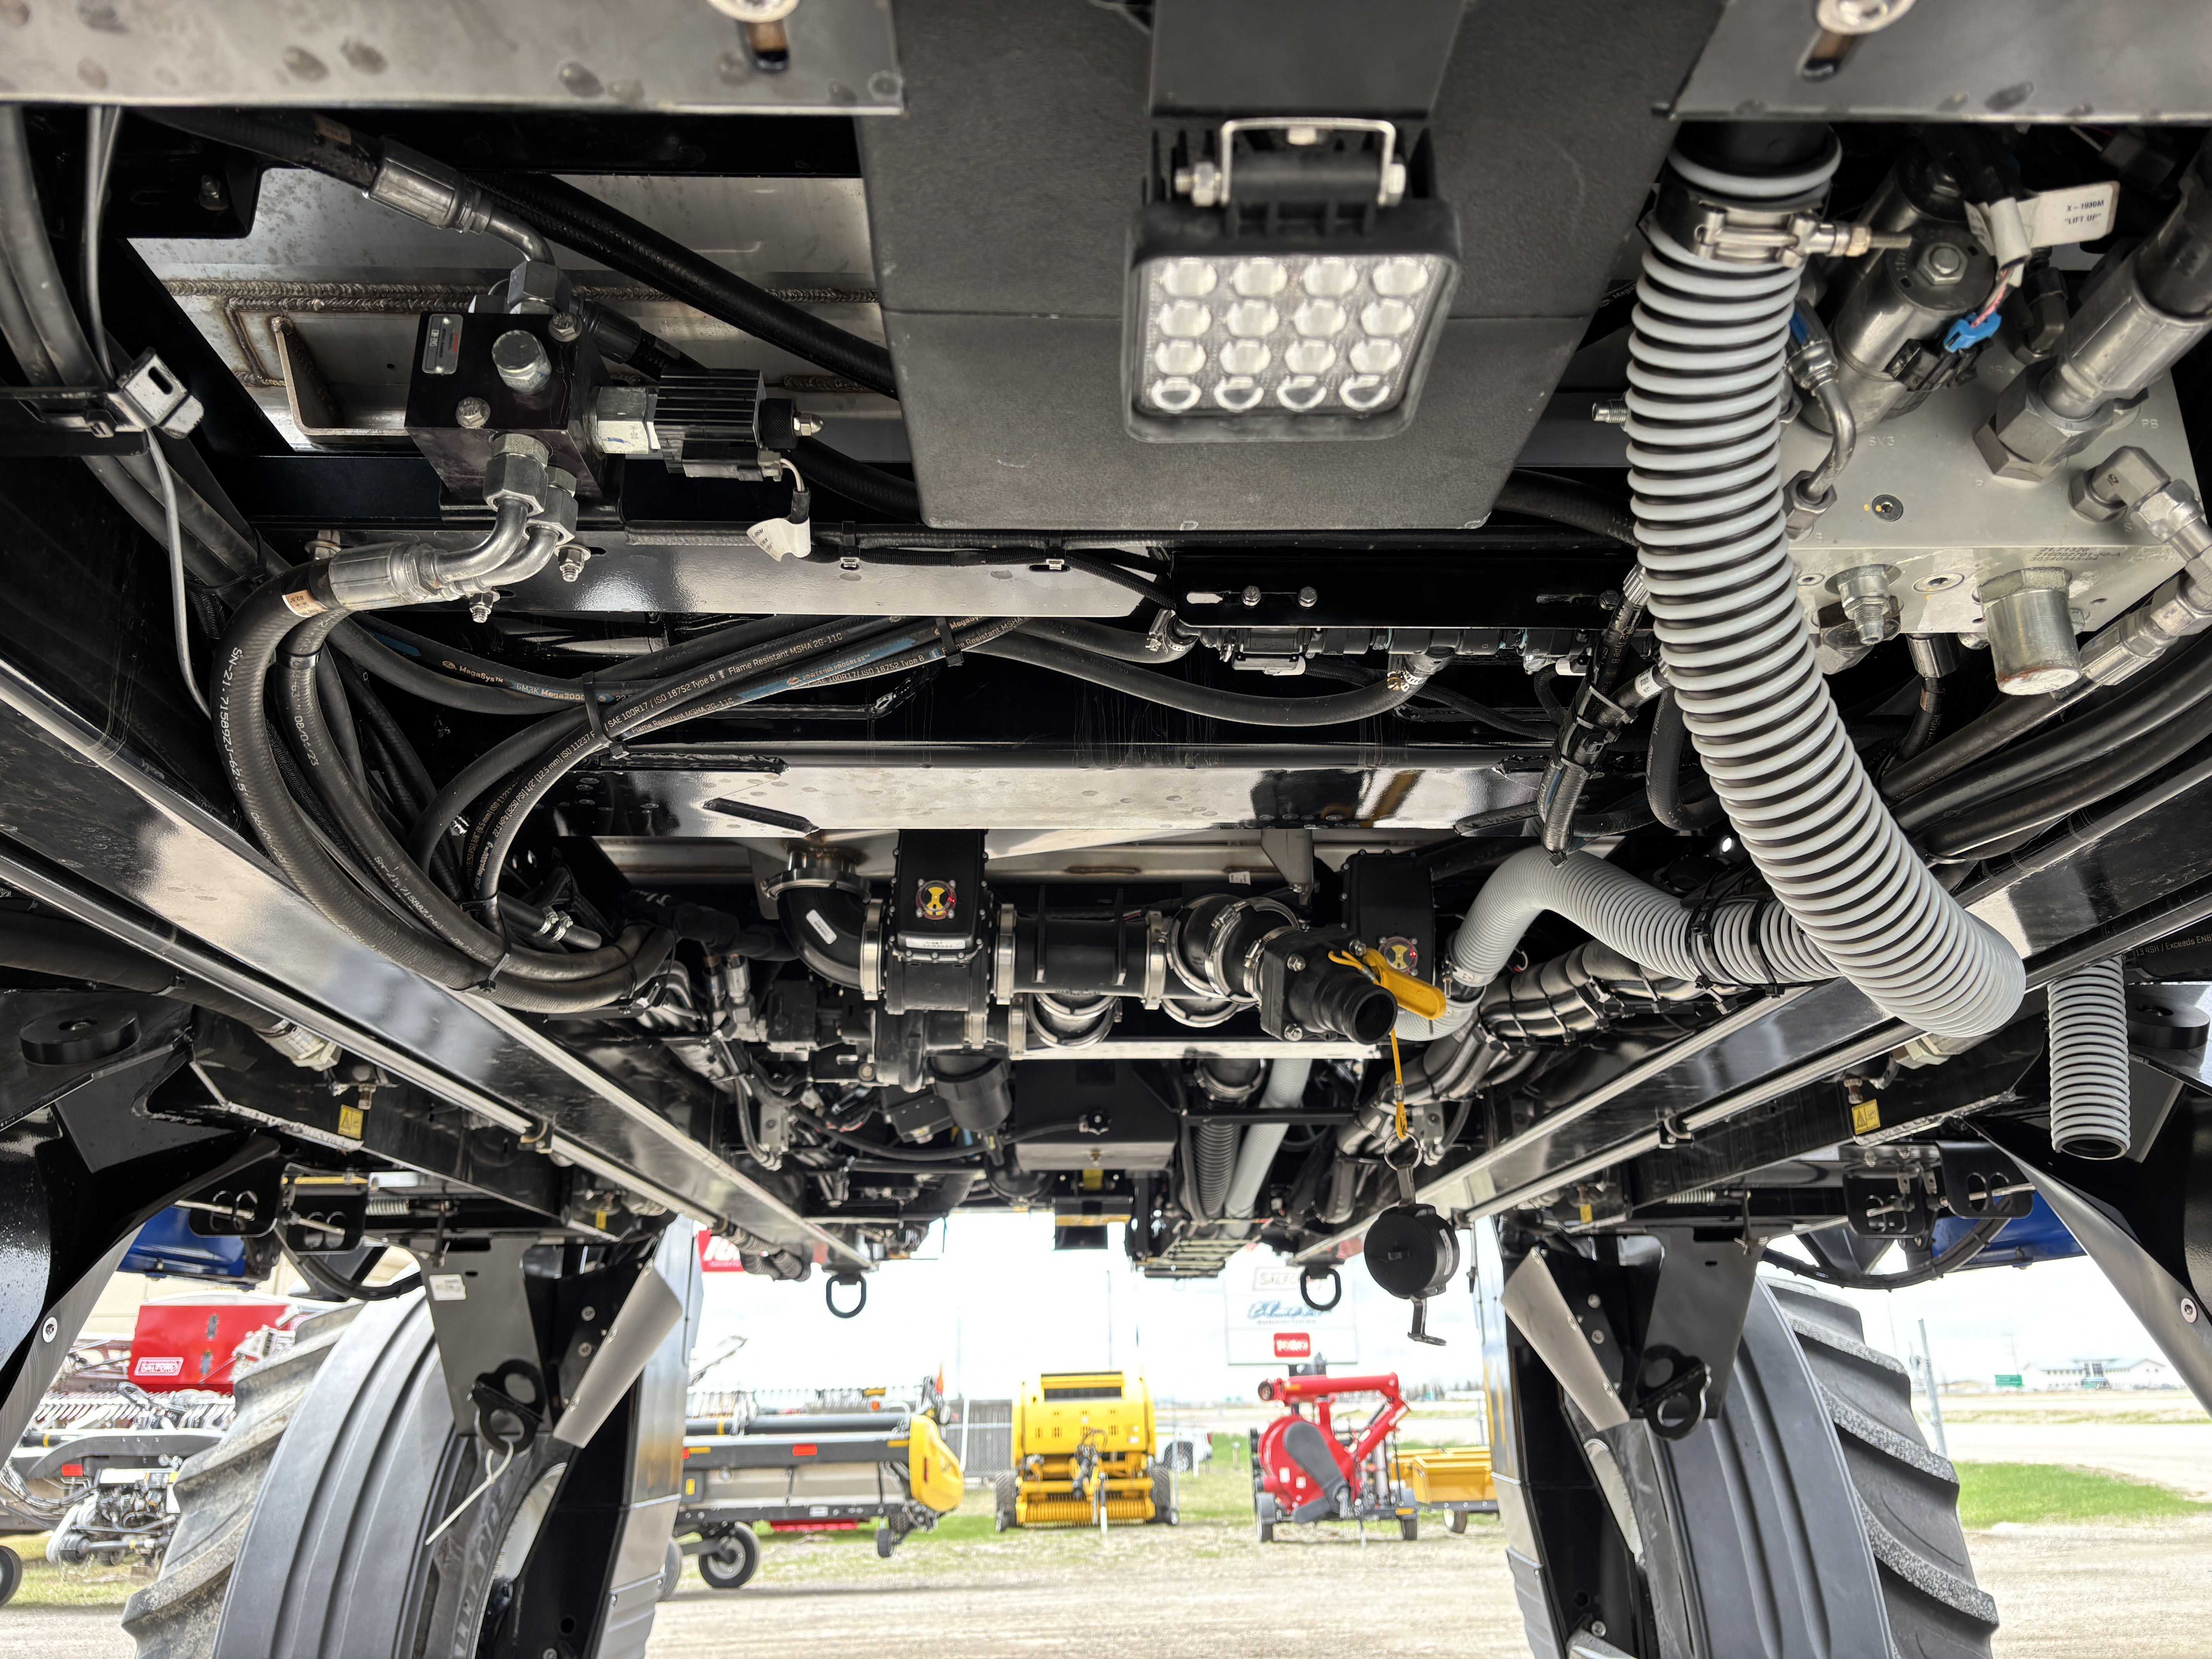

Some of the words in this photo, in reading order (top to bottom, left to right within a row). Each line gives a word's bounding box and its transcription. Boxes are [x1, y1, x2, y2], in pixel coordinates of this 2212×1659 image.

[1869, 436, 1895, 446] SV3
[965, 627, 1001, 646] Resistant
[1000, 617, 1024, 631] MSHA
[875, 662, 900, 673] 18752
[516, 683, 539, 695] 6M3K
[608, 716, 623, 728] SAE
[621, 702, 649, 721] 100R17
[654, 693, 667, 706] ISO
[666, 683, 692, 699] 18752
[690, 677, 710, 689] Type
[709, 673, 717, 682] B
[728, 663, 752, 676] Flame
[752, 650, 790, 668] Resistant
[789, 642, 813, 656] MSHA
[813, 632, 843, 648] 2G-11C
[631, 724, 652, 734] Flame
[652, 713, 685, 727] Resistant
[685, 705, 707, 717] MSHA
[706, 697, 735, 711] 2G-11C
[802, 667, 833, 680] POWERING
[560, 748, 572, 759] ISO
[570, 733, 591, 752] 11237
[489, 799, 500, 813] ISO
